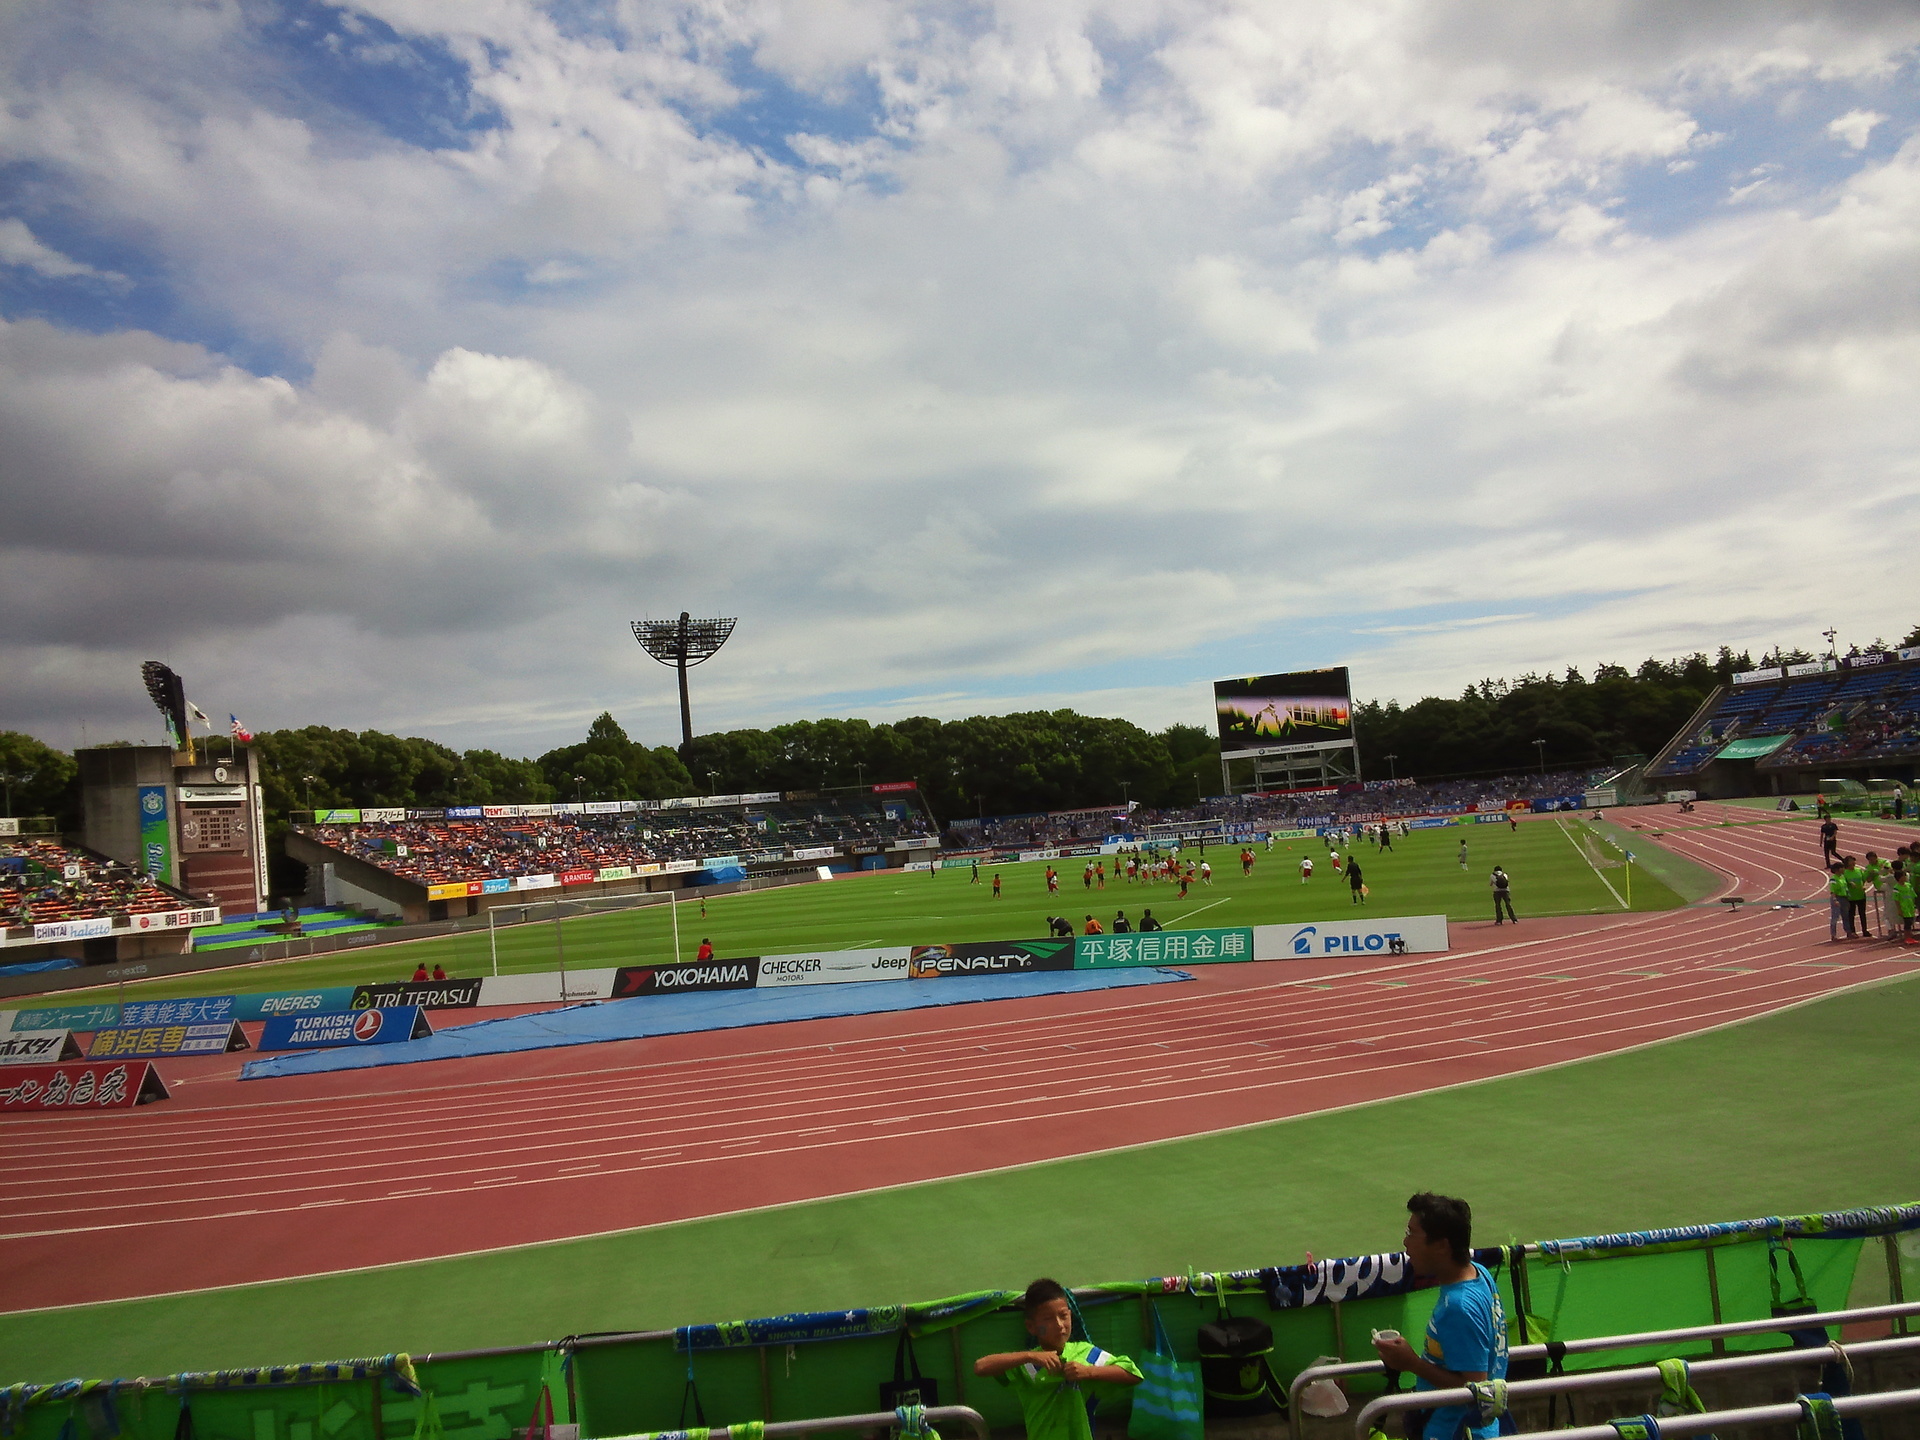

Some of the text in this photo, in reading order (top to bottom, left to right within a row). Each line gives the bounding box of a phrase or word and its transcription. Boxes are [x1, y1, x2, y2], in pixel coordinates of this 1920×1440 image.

[485, 808, 503, 816] RENT
[567, 872, 592, 882] RANTEC
[164, 909, 215, 927] 朝日新聞
[36, 923, 110, 939] CHINTAI haletto
[1080, 933, 1245, 963] 平塚信用金庫
[1324, 932, 1401, 953] PILOT
[761, 958, 822, 975] CHECKER
[871, 955, 907, 970] Jeep
[920, 954, 1031, 973] PENALTY
[653, 964, 749, 988] YOKOHAMA
[776, 974, 804, 982] MOTORS
[260, 994, 322, 1012] ENERES
[406, 988, 473, 1006] TERASU
[119, 998, 231, 1026] 産業能率大学
[295, 1014, 355, 1030] TURKISH
[89, 1025, 188, 1056] 横浜医専
[288, 1027, 352, 1043] AIRLINES
[1822, 1207, 1897, 1229] SHONAN
